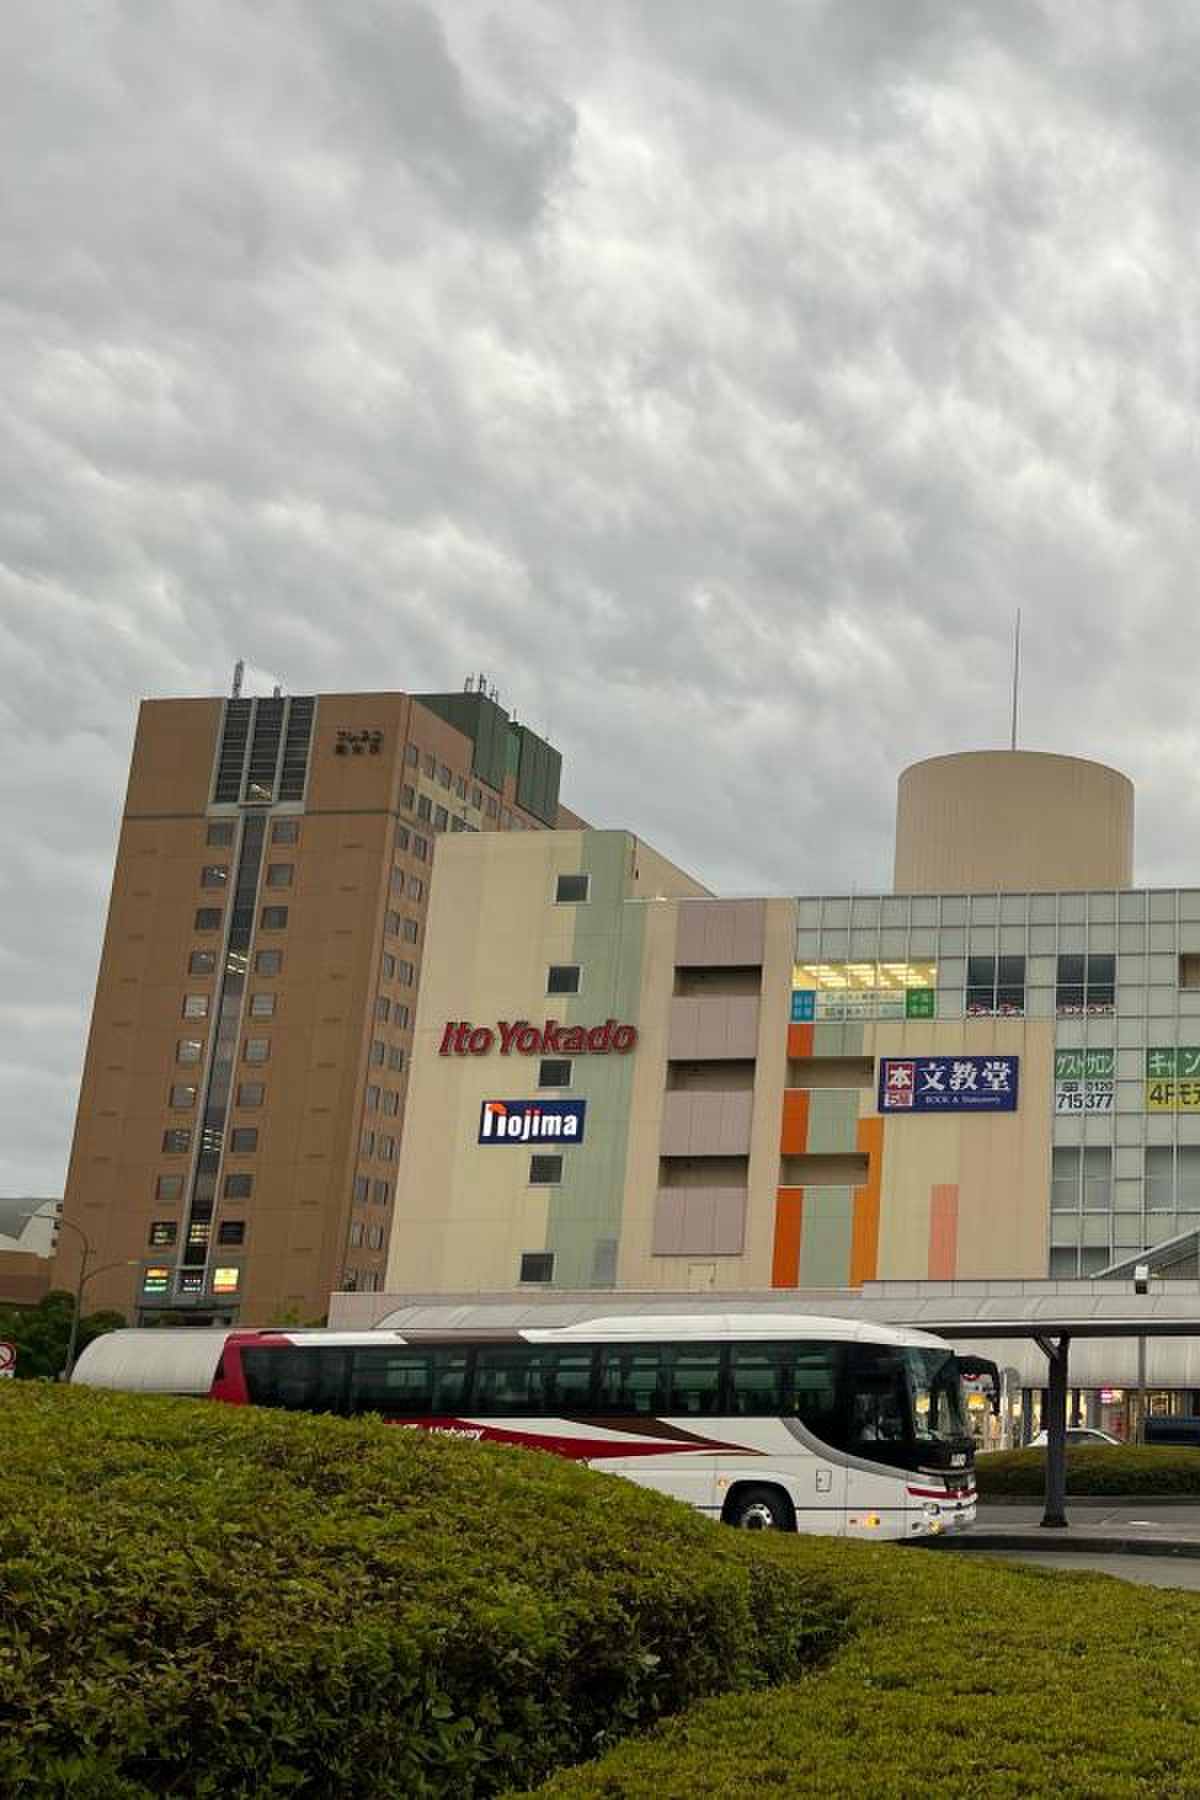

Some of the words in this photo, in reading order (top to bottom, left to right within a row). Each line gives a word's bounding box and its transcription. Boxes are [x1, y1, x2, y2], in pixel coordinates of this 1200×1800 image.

[889, 1067, 912, 1088] 本
[918, 1061, 1011, 1090] 文教堂
